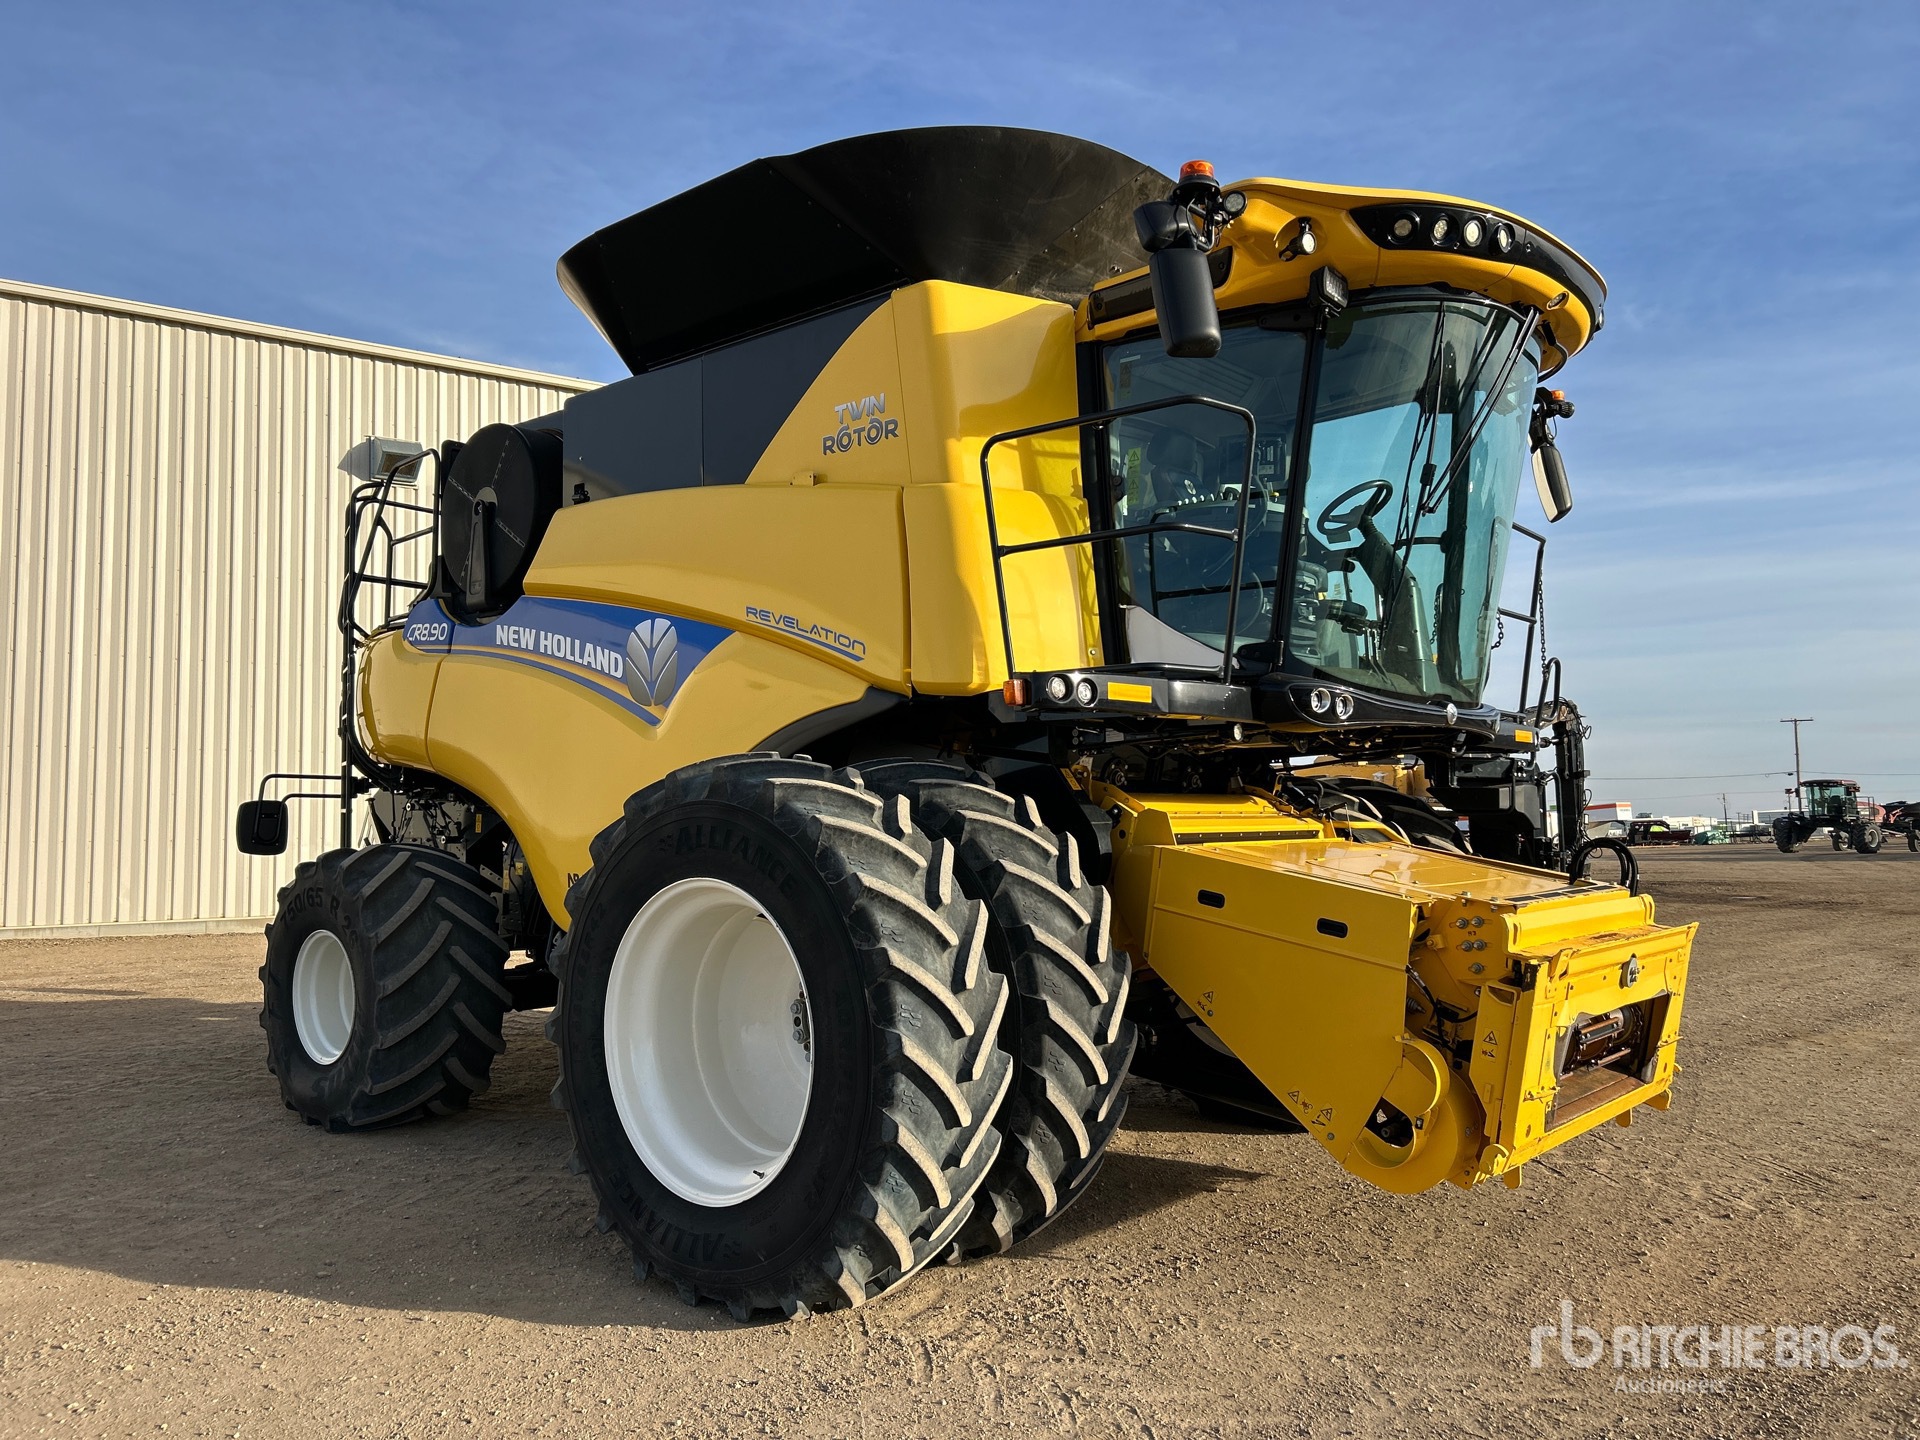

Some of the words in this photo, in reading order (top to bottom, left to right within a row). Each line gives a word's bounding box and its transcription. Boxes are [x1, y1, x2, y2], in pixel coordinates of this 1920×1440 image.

[834, 392, 885, 424] TWIN
[822, 417, 899, 455] ROTOR
[407, 622, 448, 641] CR8.90
[496, 624, 536, 651] NEW
[540, 630, 624, 679] HOLLAND
[745, 605, 866, 655] REVELATION
[675, 824, 797, 900] ALLIANCE
[608, 1171, 725, 1261] ALLIANCE
